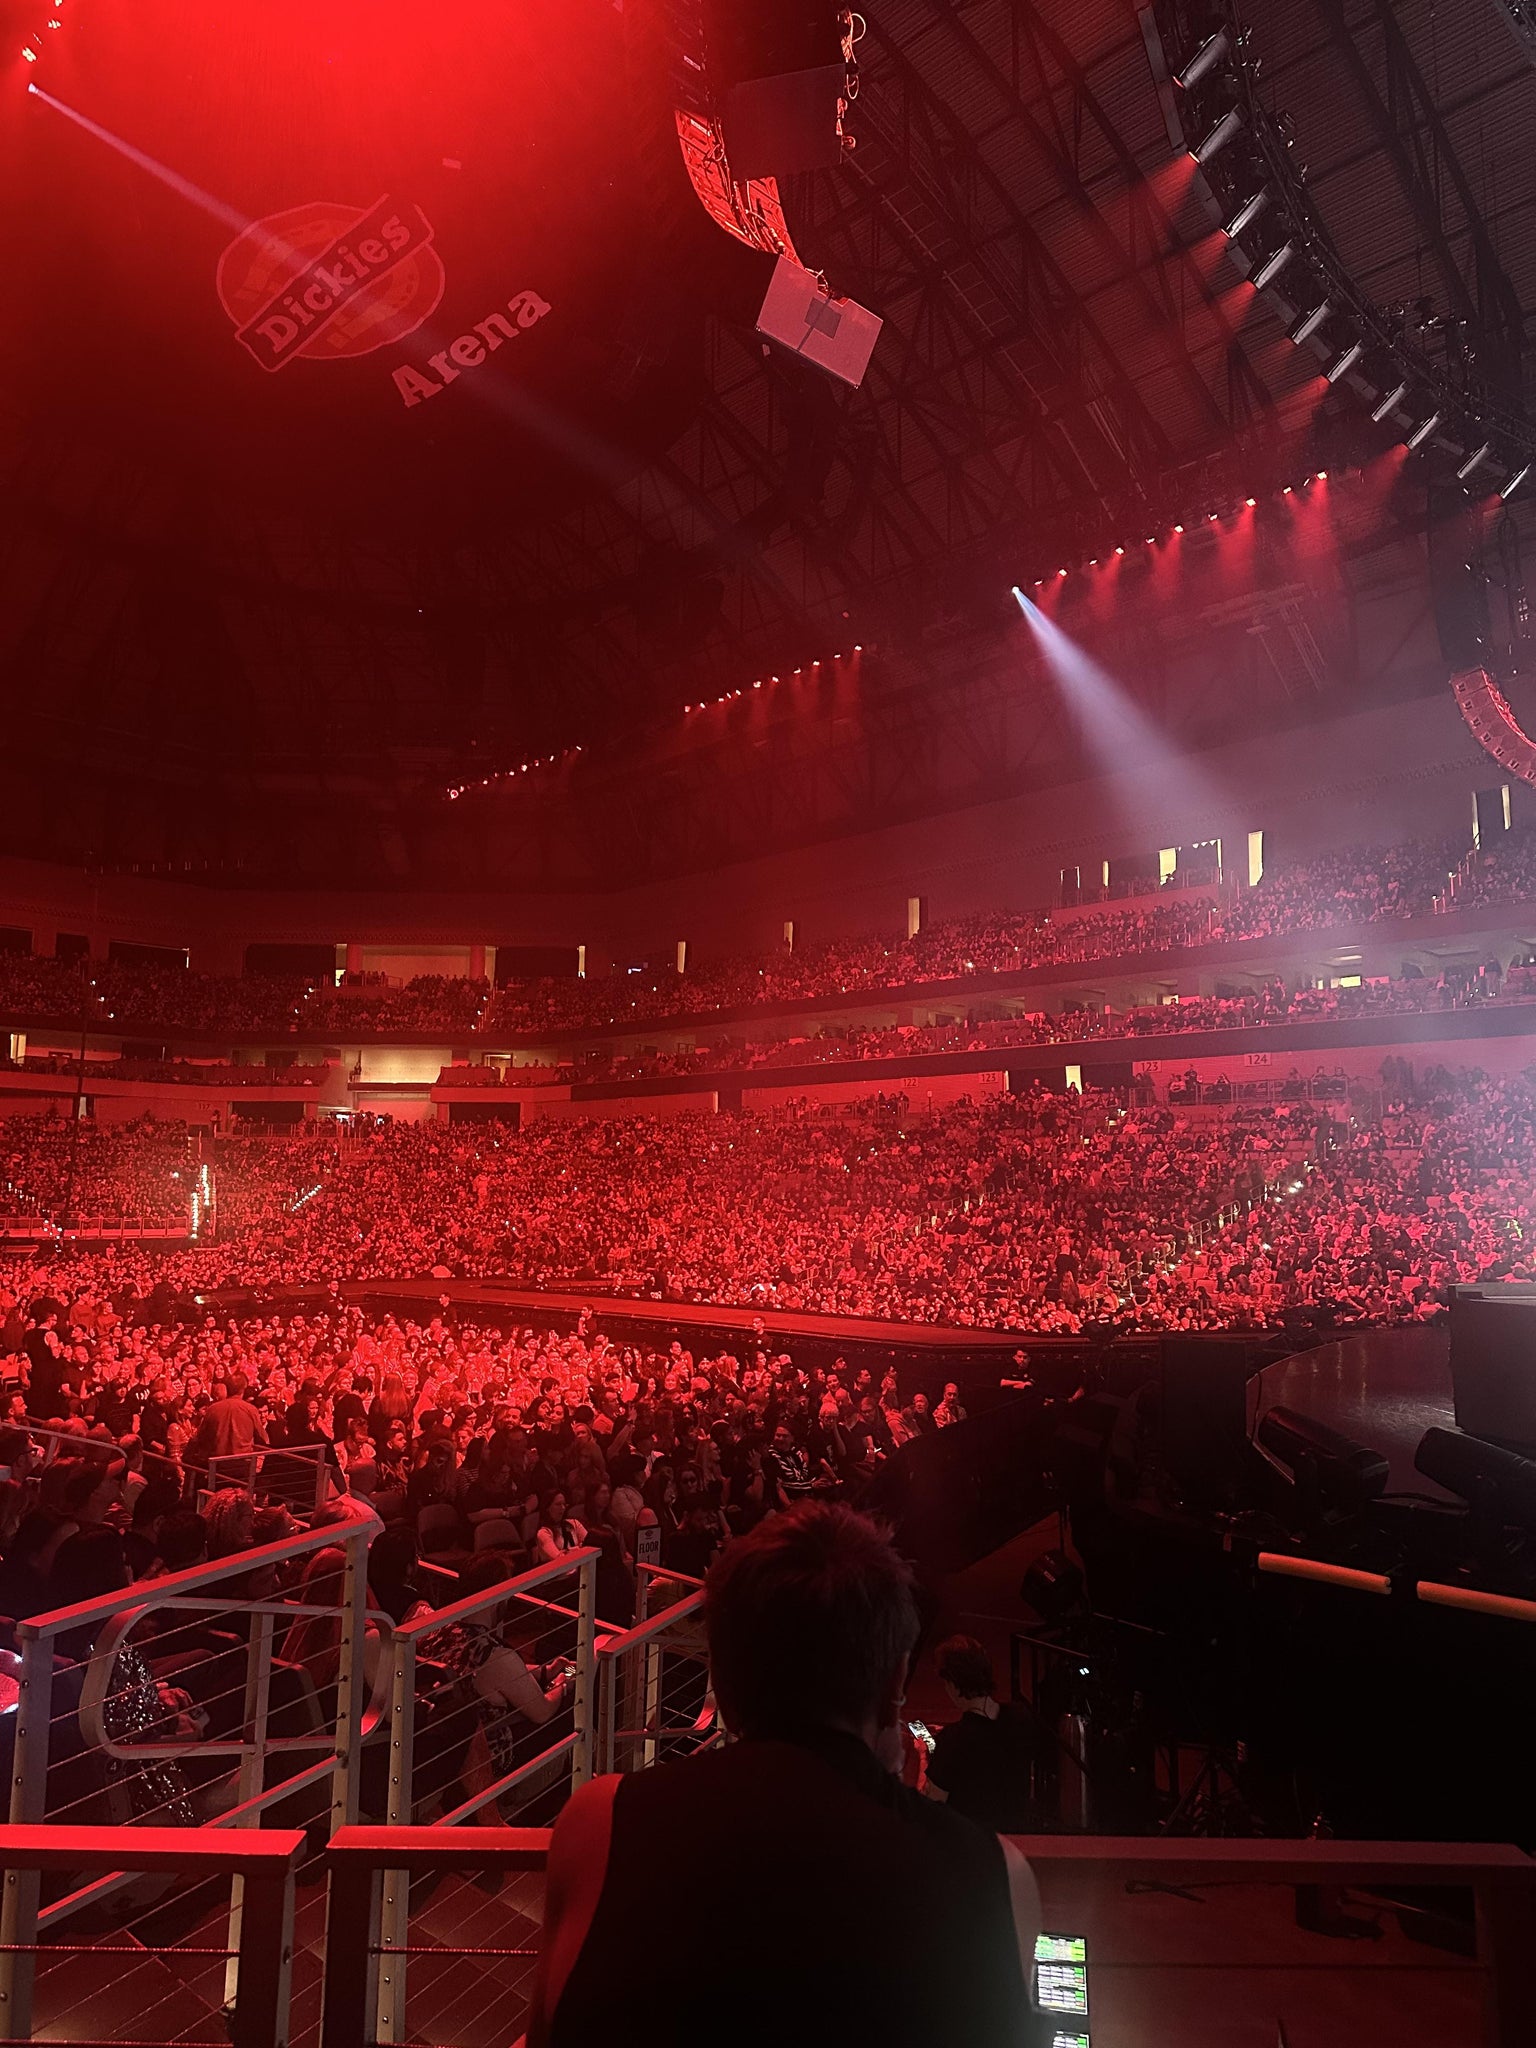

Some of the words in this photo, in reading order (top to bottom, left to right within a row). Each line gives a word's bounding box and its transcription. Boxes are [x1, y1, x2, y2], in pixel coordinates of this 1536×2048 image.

[256, 214, 411, 353] Dickies
[391, 289, 552, 407] Arena
[1248, 1054, 1267, 1065] 124
[1141, 1062, 1159, 1072] 123
[903, 1079, 917, 1087] 122
[981, 1074, 996, 1082] 123
[639, 1541, 659, 1554] FLOOR
